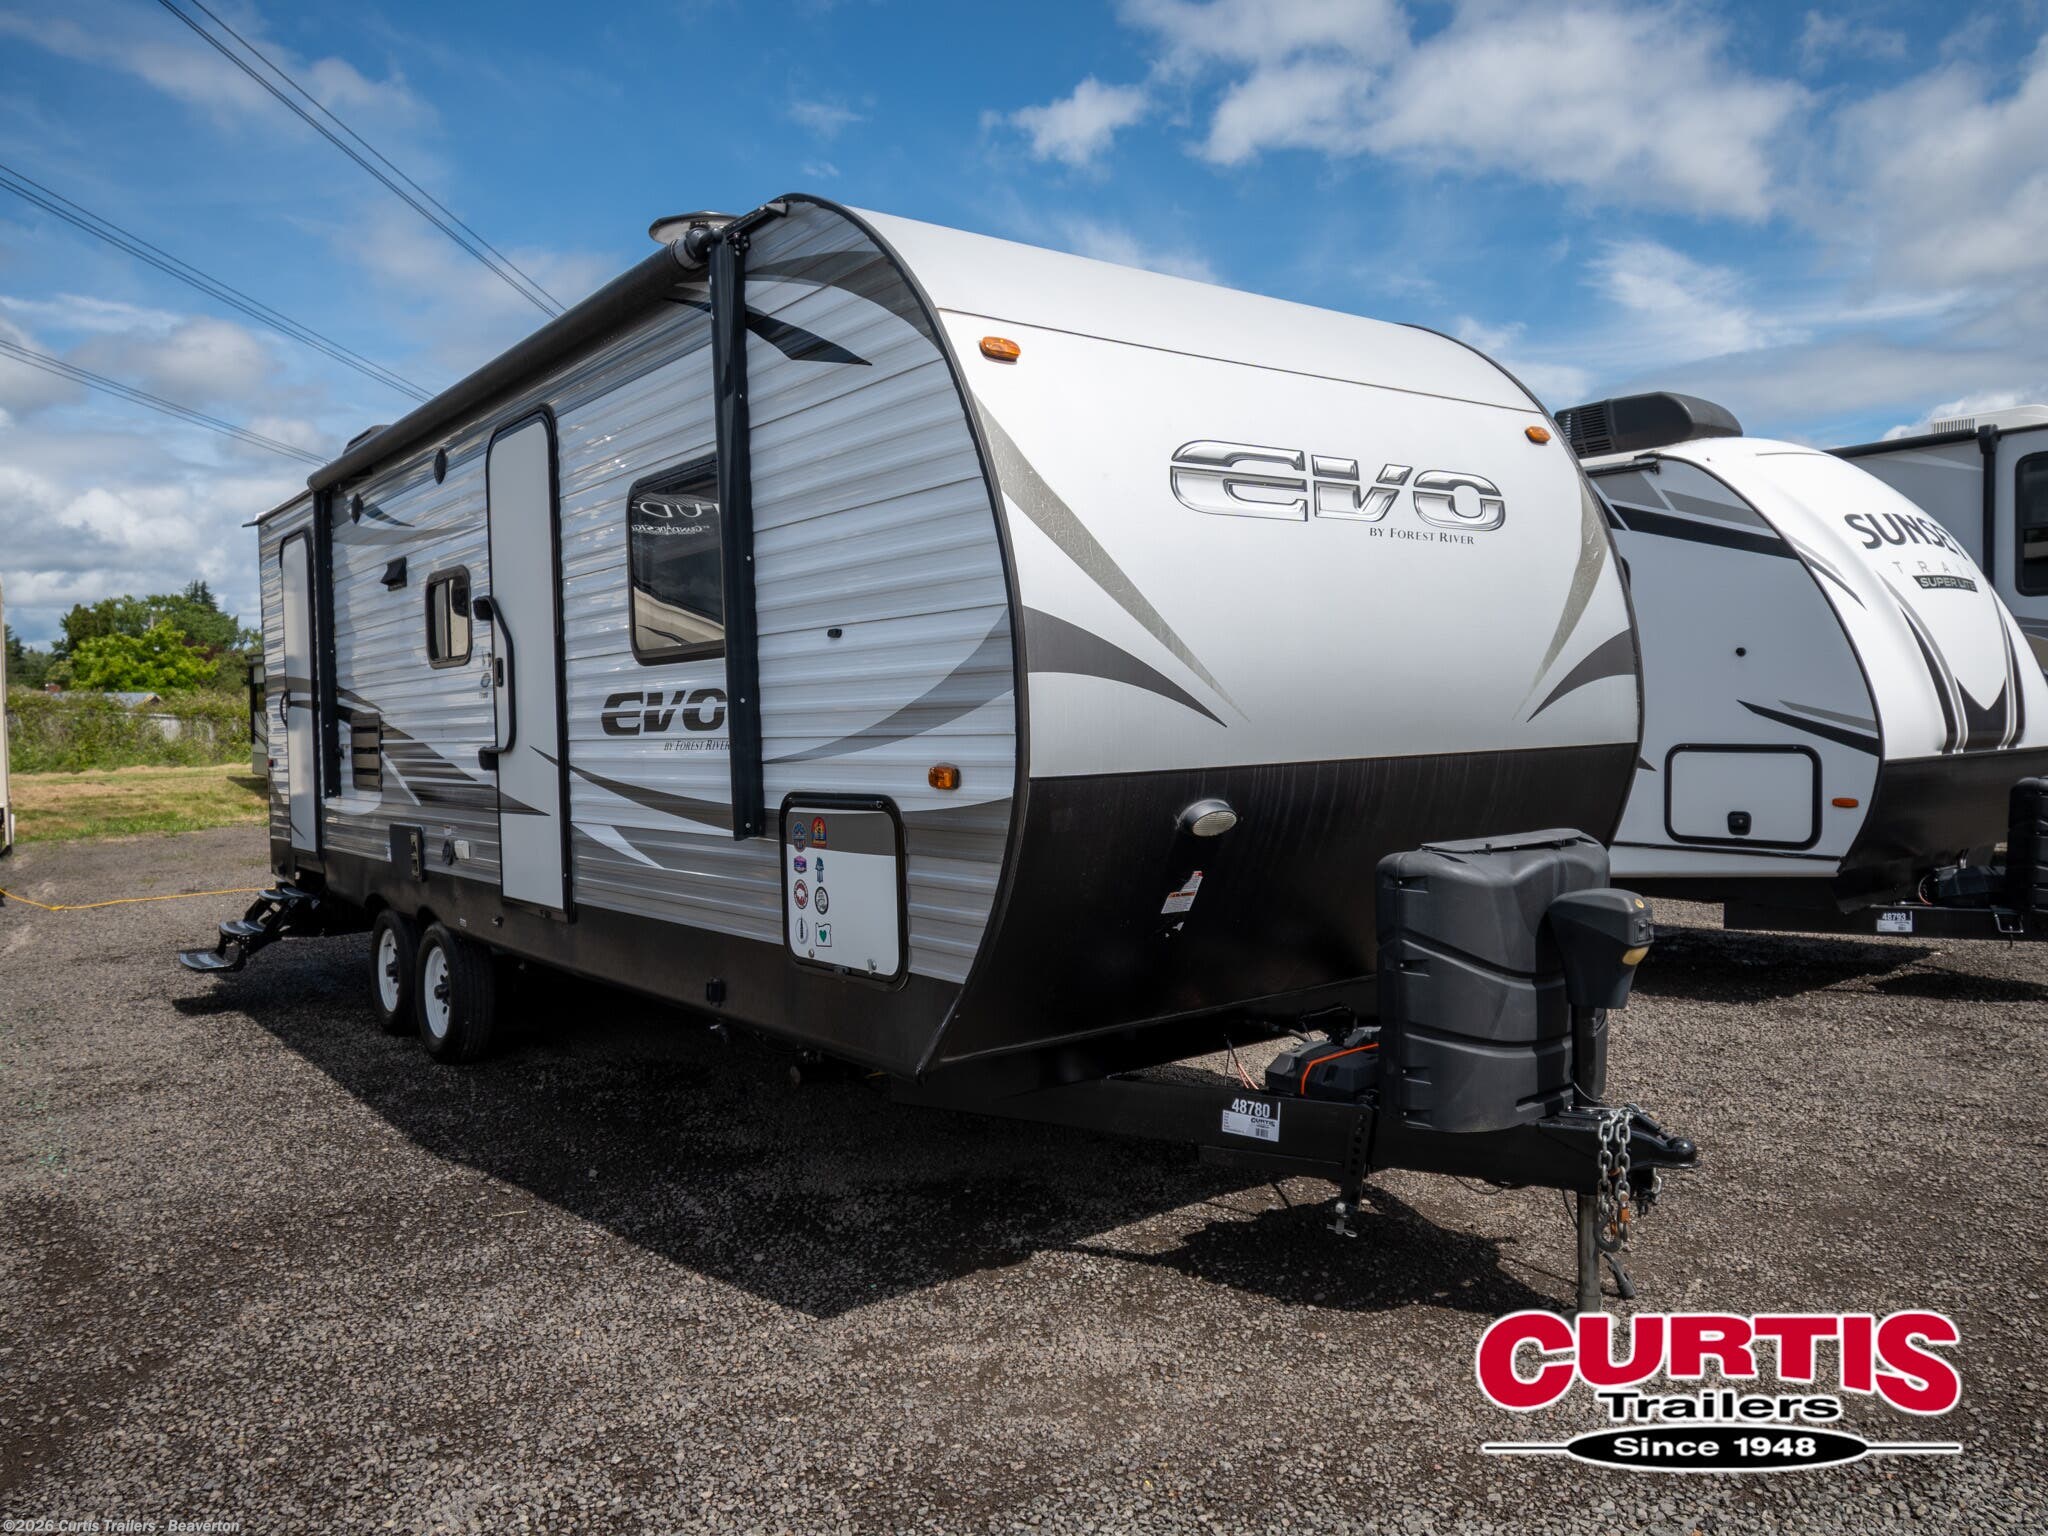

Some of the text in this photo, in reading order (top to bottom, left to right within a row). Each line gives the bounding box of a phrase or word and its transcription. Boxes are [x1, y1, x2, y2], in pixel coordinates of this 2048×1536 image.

[1169, 439, 1506, 531] EVO
[1369, 527, 1474, 545] BY FOREST RIVER
[1844, 513, 1968, 560] SUNSET
[600, 688, 728, 736] EVO
[674, 740, 705, 751] FOREST
[1882, 912, 1907, 921] 48793
[1231, 1097, 1271, 1118] 48780
